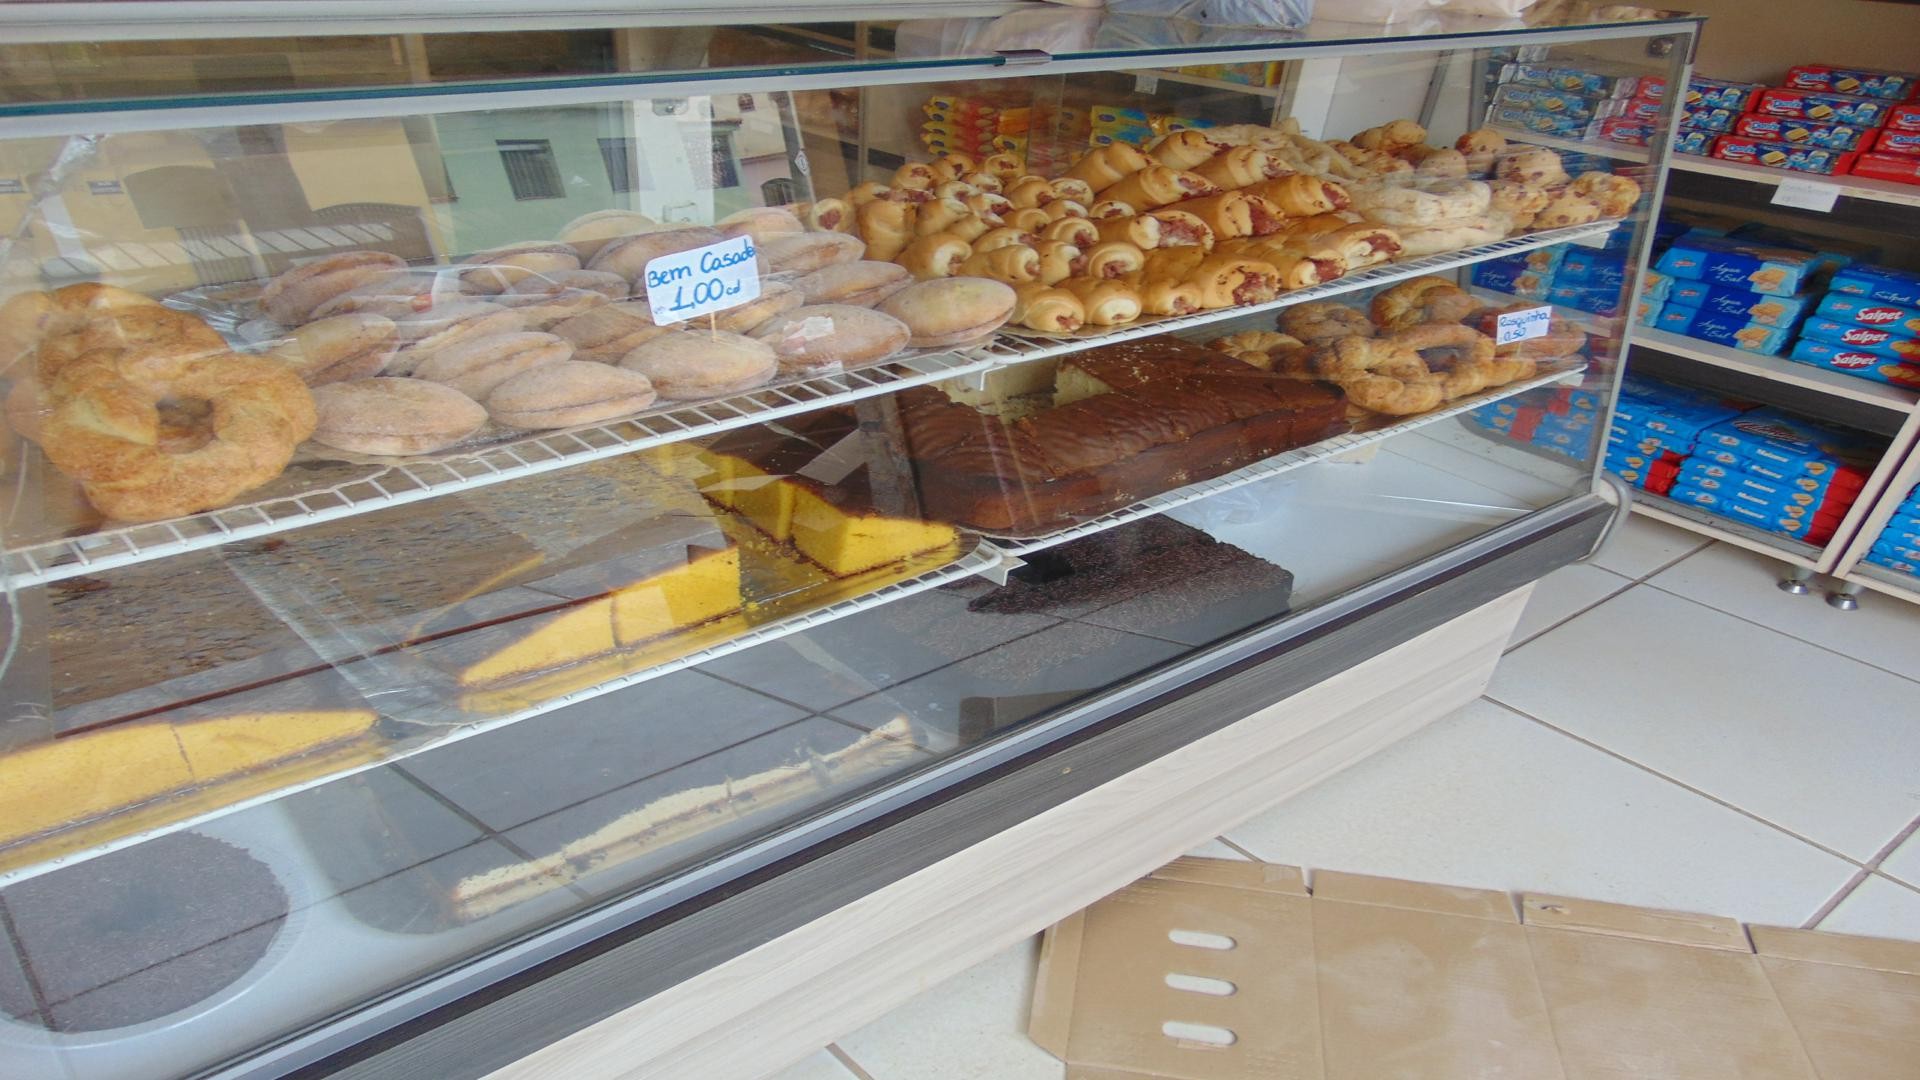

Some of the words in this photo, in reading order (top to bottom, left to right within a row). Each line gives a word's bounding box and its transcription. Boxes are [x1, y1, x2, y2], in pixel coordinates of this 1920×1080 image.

[648, 265, 692, 288] Bem
[700, 239, 756, 273] Casado
[1855, 308, 1904, 323] Salpet
[1841, 328, 1890, 344] Salpet
[1830, 352, 1878, 367] Salpet
